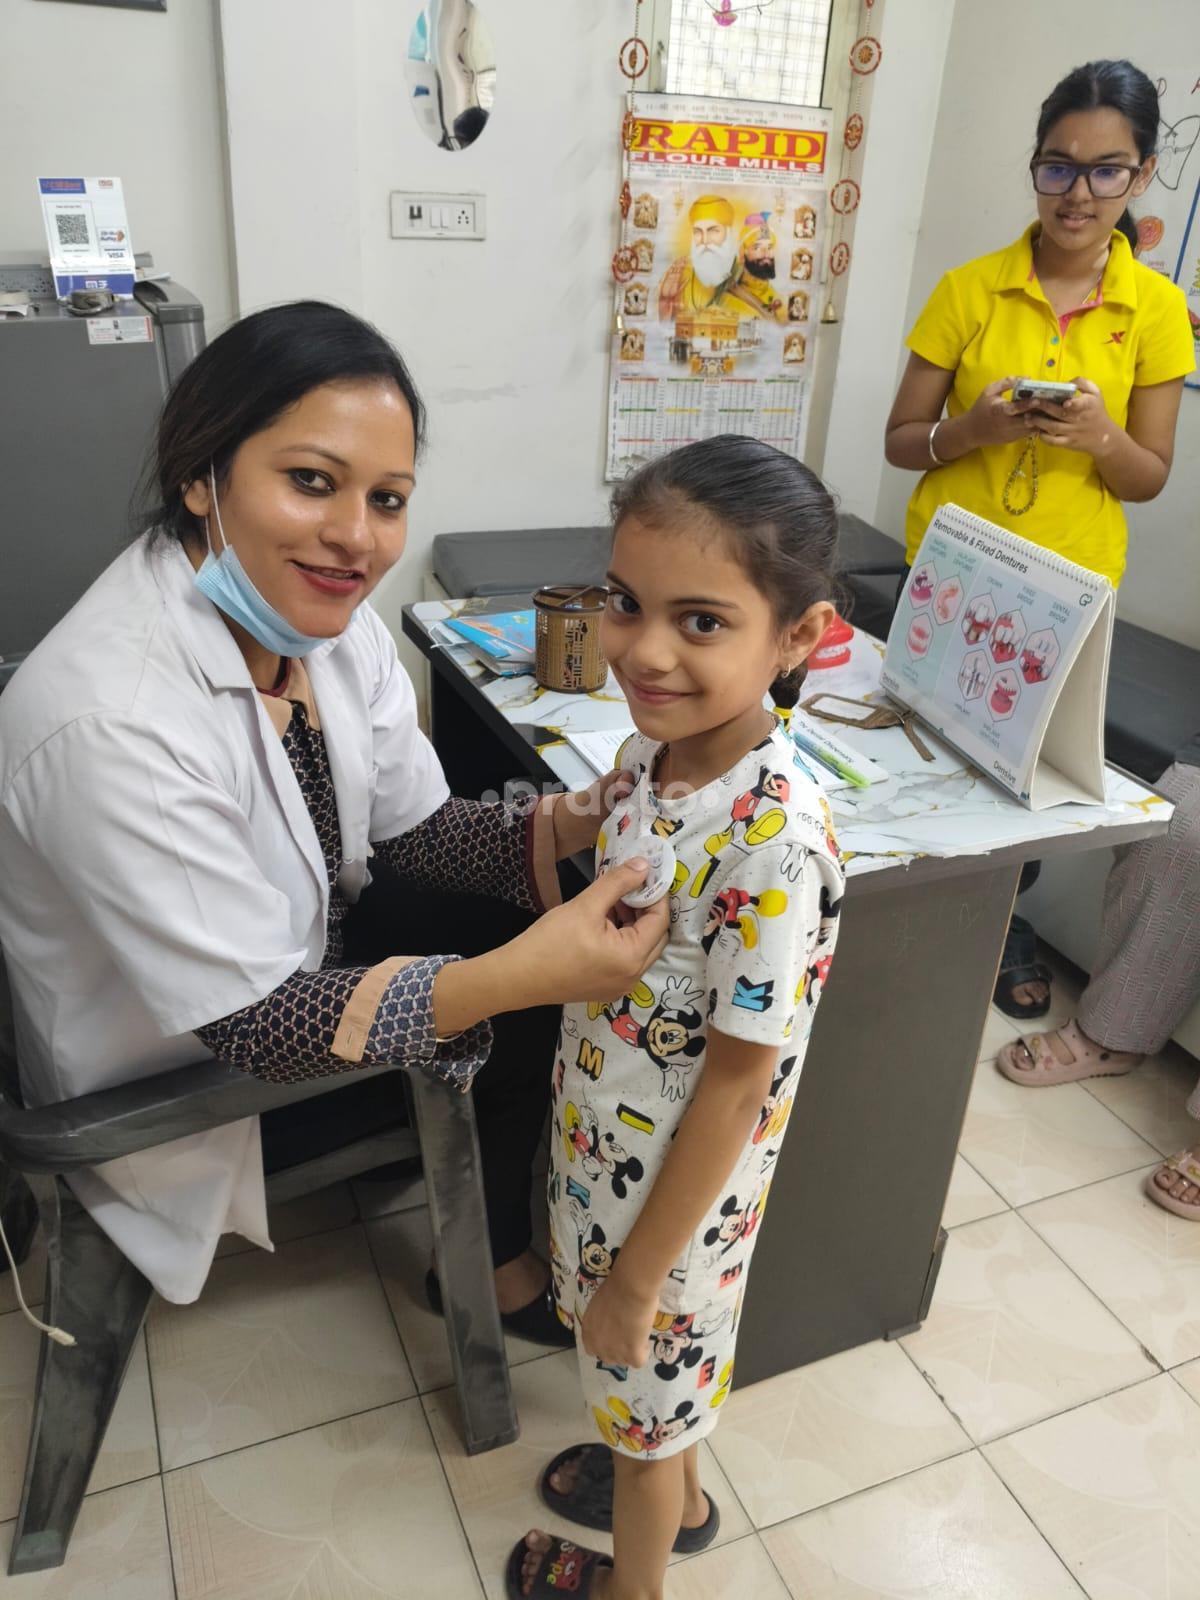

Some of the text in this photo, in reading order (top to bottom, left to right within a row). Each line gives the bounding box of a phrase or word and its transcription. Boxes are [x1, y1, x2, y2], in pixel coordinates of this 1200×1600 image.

[635, 123, 821, 159] RAPID
[631, 151, 823, 173] FLOUR MILLS
[933, 518, 969, 544] Removable
[969, 537, 976, 547] &
[974, 539, 996, 558] Fixed
[995, 549, 1029, 574] Dentures
